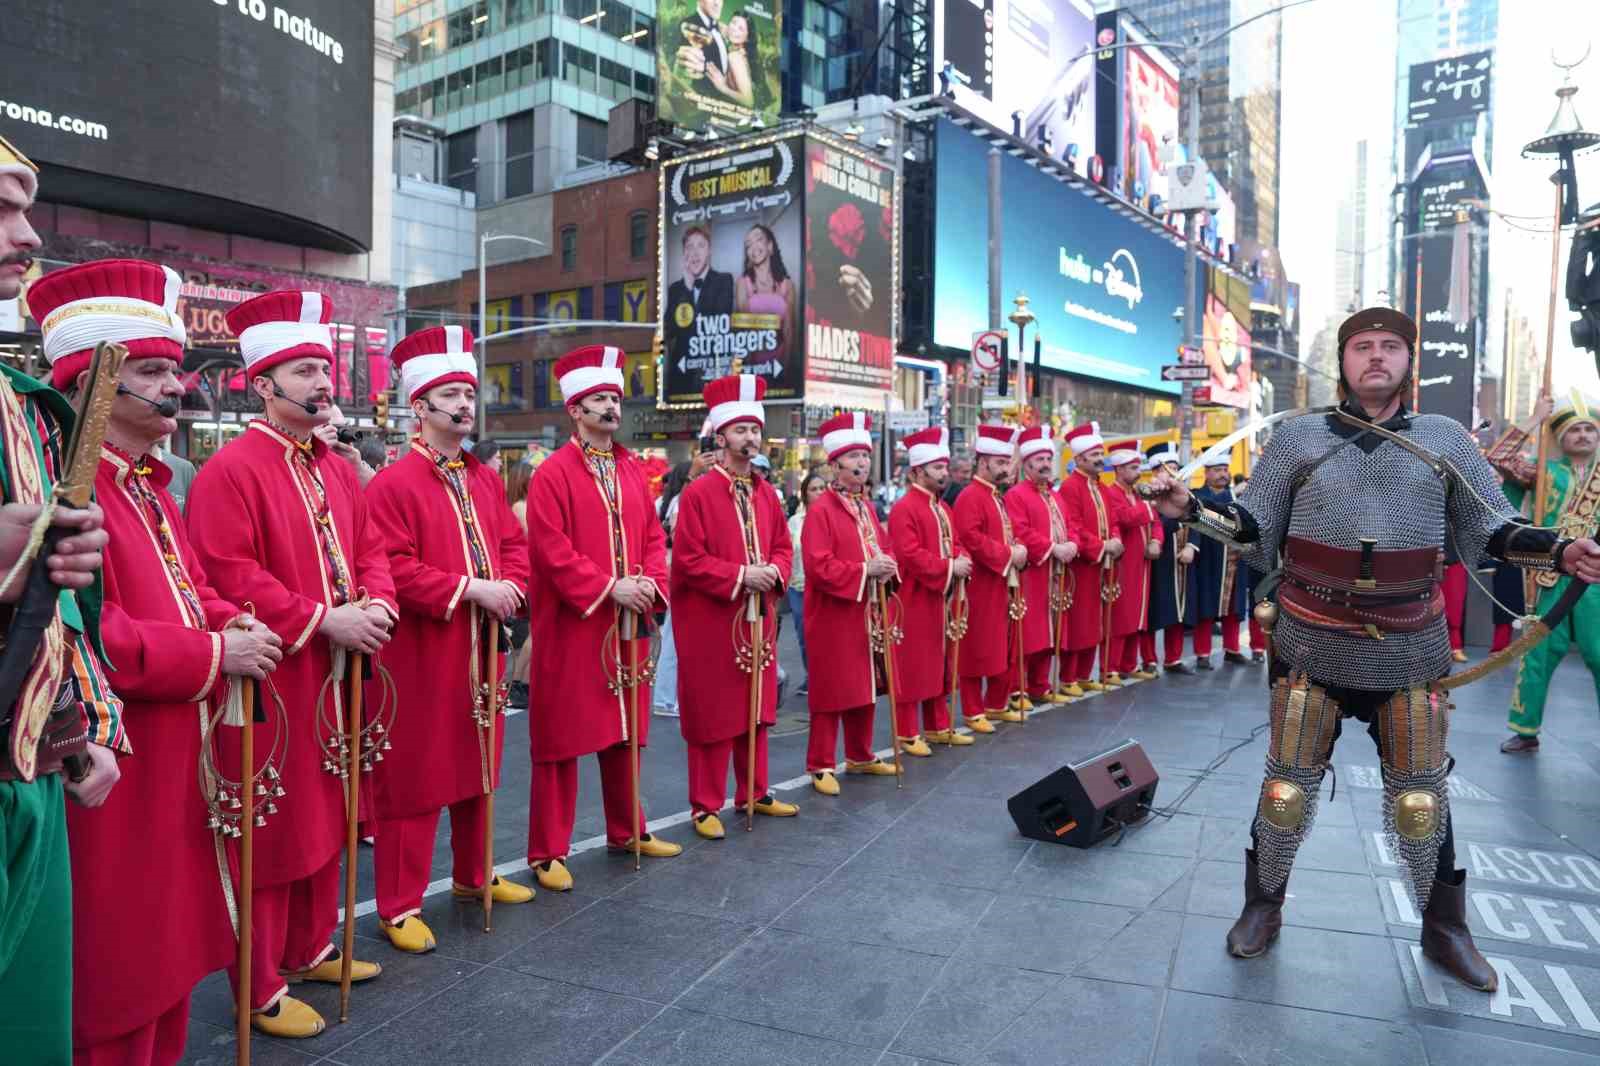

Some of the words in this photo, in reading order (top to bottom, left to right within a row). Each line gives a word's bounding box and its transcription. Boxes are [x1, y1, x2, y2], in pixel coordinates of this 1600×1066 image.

[273, 6, 344, 64] nature
[690, 178, 719, 201] BEST
[719, 165, 773, 194] MUSICAL
[696, 312, 731, 337] two
[688, 329, 777, 358] strangers
